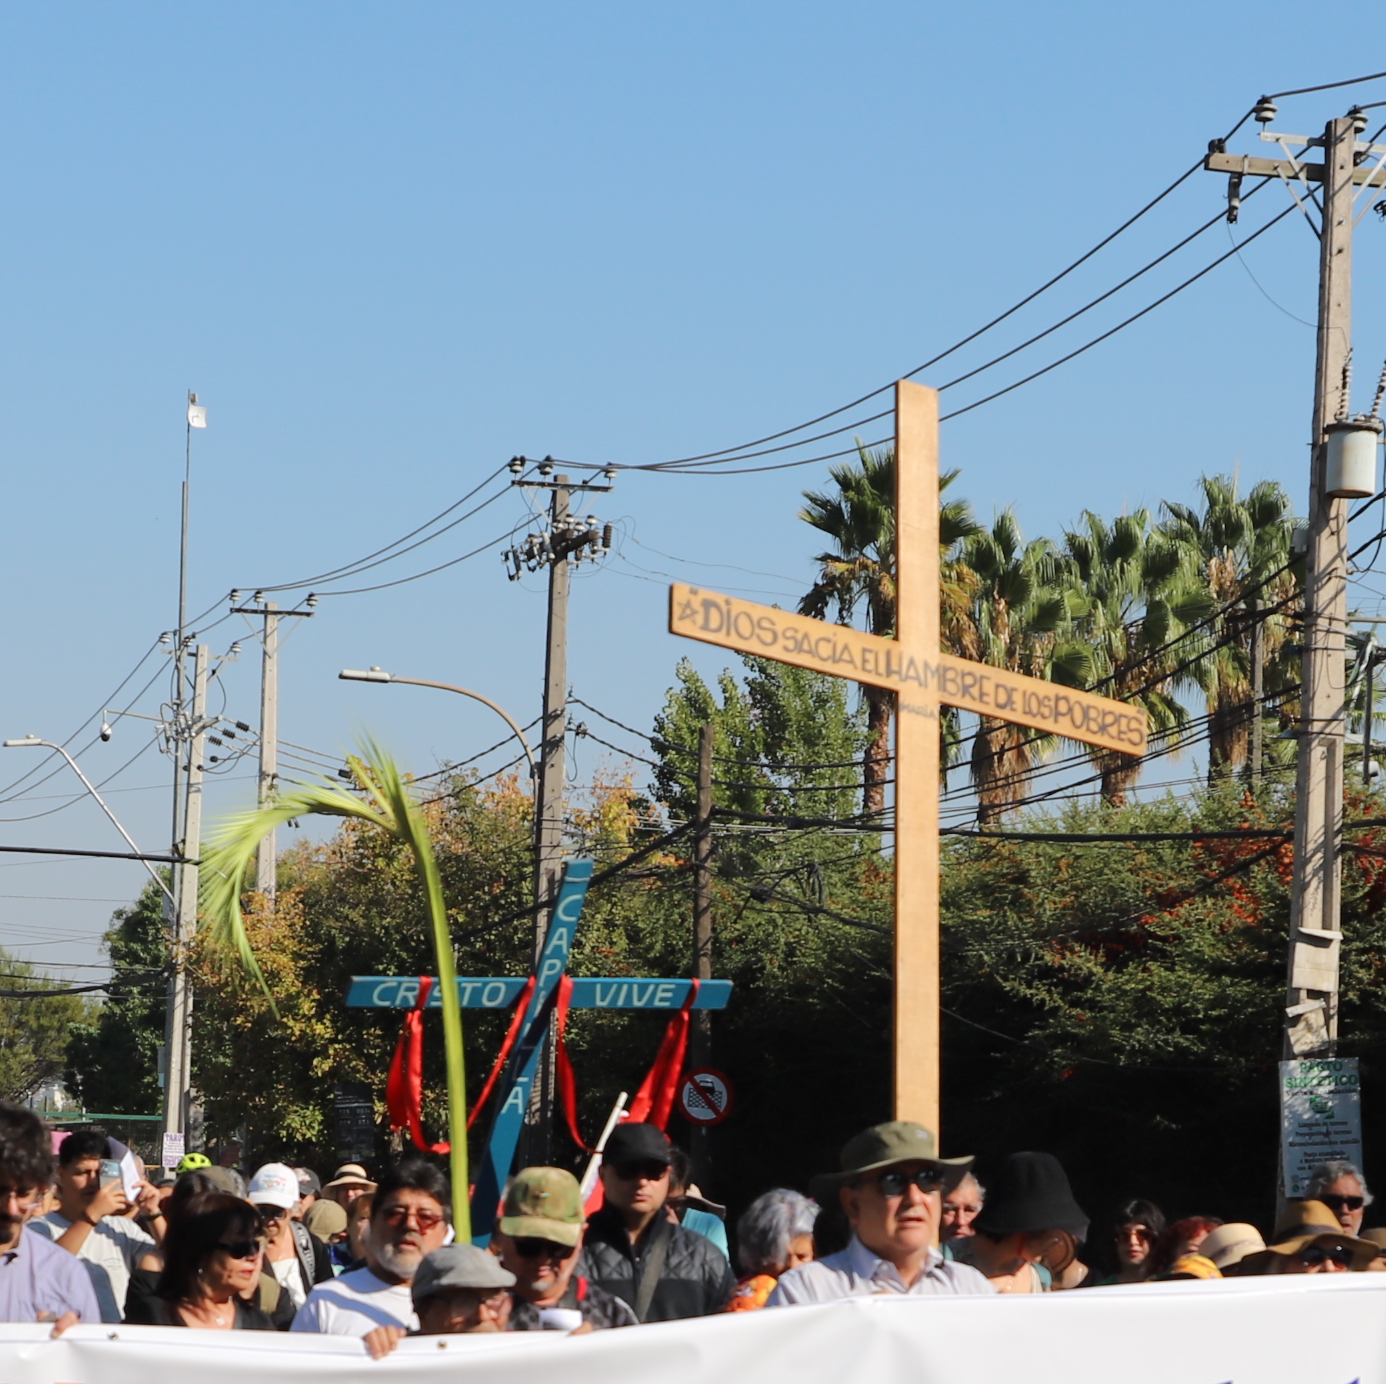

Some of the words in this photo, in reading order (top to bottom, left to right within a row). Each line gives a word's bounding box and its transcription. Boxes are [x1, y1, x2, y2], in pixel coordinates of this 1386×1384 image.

[861, 647, 884, 677] EL
[885, 649, 992, 705] HAMBRE
[995, 683, 1019, 712] DE
[1023, 690, 1054, 720] LOS
[373, 981, 507, 1007] CRSTO
[595, 983, 676, 1007] VIVE
